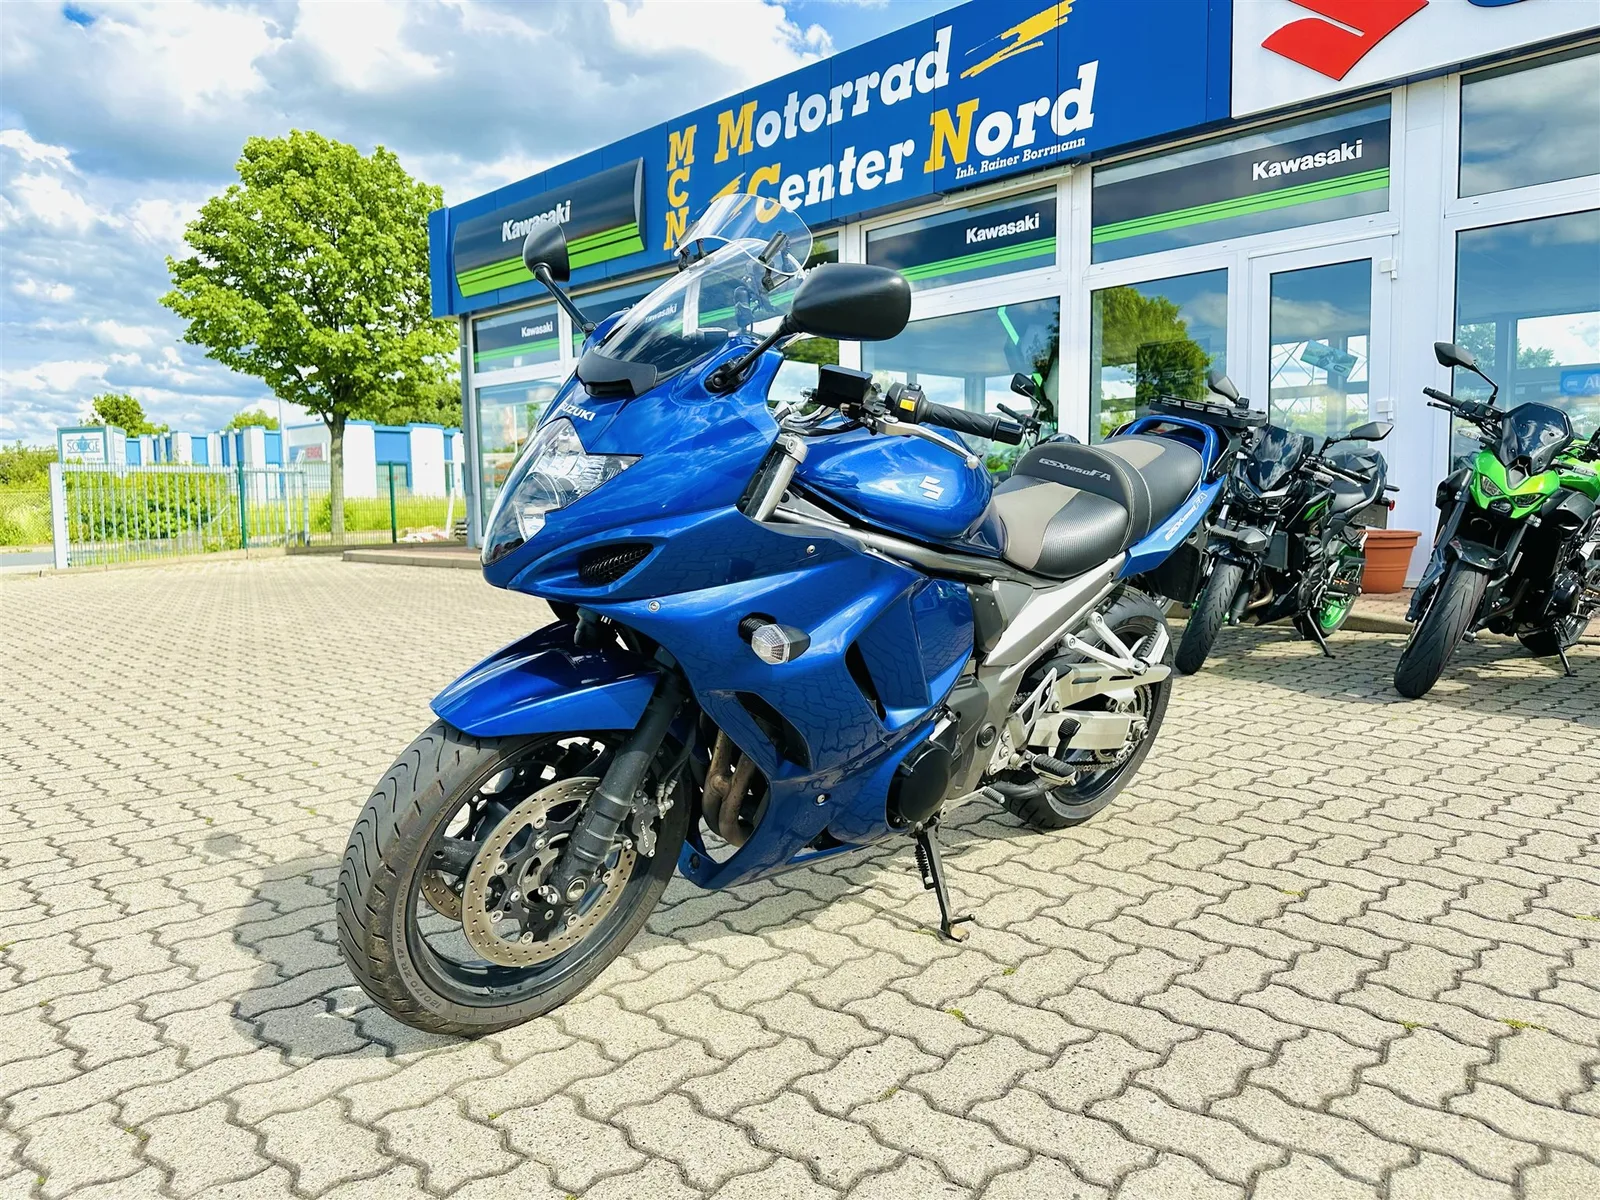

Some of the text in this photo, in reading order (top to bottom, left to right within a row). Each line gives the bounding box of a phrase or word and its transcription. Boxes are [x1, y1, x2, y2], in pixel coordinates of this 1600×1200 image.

[714, 25, 953, 164] Motorrad
[747, 60, 1098, 223] Center Nord
[955, 137, 1086, 180] Inh. Rainer Borrmann
[1251, 140, 1363, 182] Kawasaki
[965, 213, 1041, 244] Kawasaki
[521, 321, 554, 338] Kawasaki
